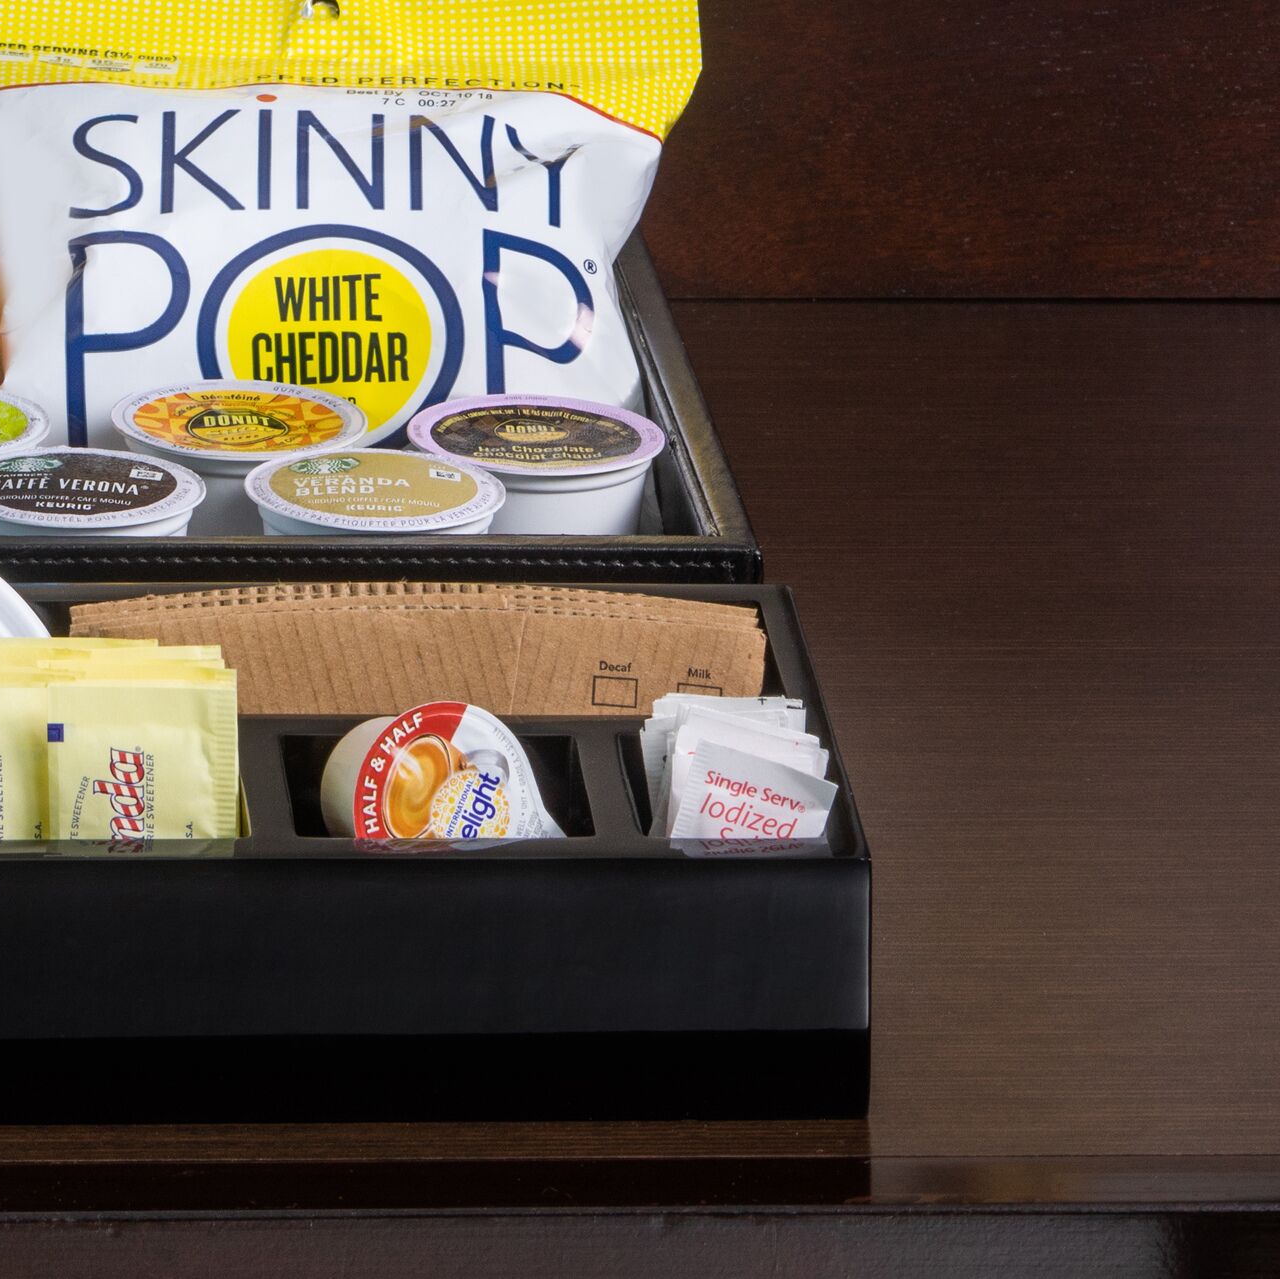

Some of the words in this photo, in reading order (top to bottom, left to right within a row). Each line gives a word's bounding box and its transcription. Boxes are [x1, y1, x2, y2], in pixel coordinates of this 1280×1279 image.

[32, 45, 98, 57] SERVING
[358, 76, 564, 90] PERFECTION
[384, 89, 403, 97] By
[418, 90, 448, 98] OCT
[395, 97, 406, 105] C
[418, 99, 456, 107] 00:27
[68, 94, 586, 228] SKINNY
[273, 272, 383, 322] WHITE
[64, 223, 595, 449] POP
[250, 330, 410, 384] CHEDDAR
[203, 415, 270, 426] DONUT
[512, 445, 595, 453] Chocolate
[59, 478, 140, 495] VERONA
[293, 477, 411, 488] VERANDA
[295, 486, 376, 497] BLEND
[35, 501, 93, 510] KEURIG
[99, 497, 132, 506] MOULU
[346, 504, 404, 512] KEURIG
[599, 660, 632, 673] Decaf
[687, 667, 712, 680] Milk
[379, 711, 424, 755] HALF
[370, 756, 386, 772] &
[146, 753, 155, 821] SWEETENER
[704, 770, 758, 798] Single
[72, 776, 91, 831] SWEETENER
[361, 776, 380, 834] HALF
[445, 778, 474, 839] INTERNATIONAL
[461, 772, 500, 840] elight
